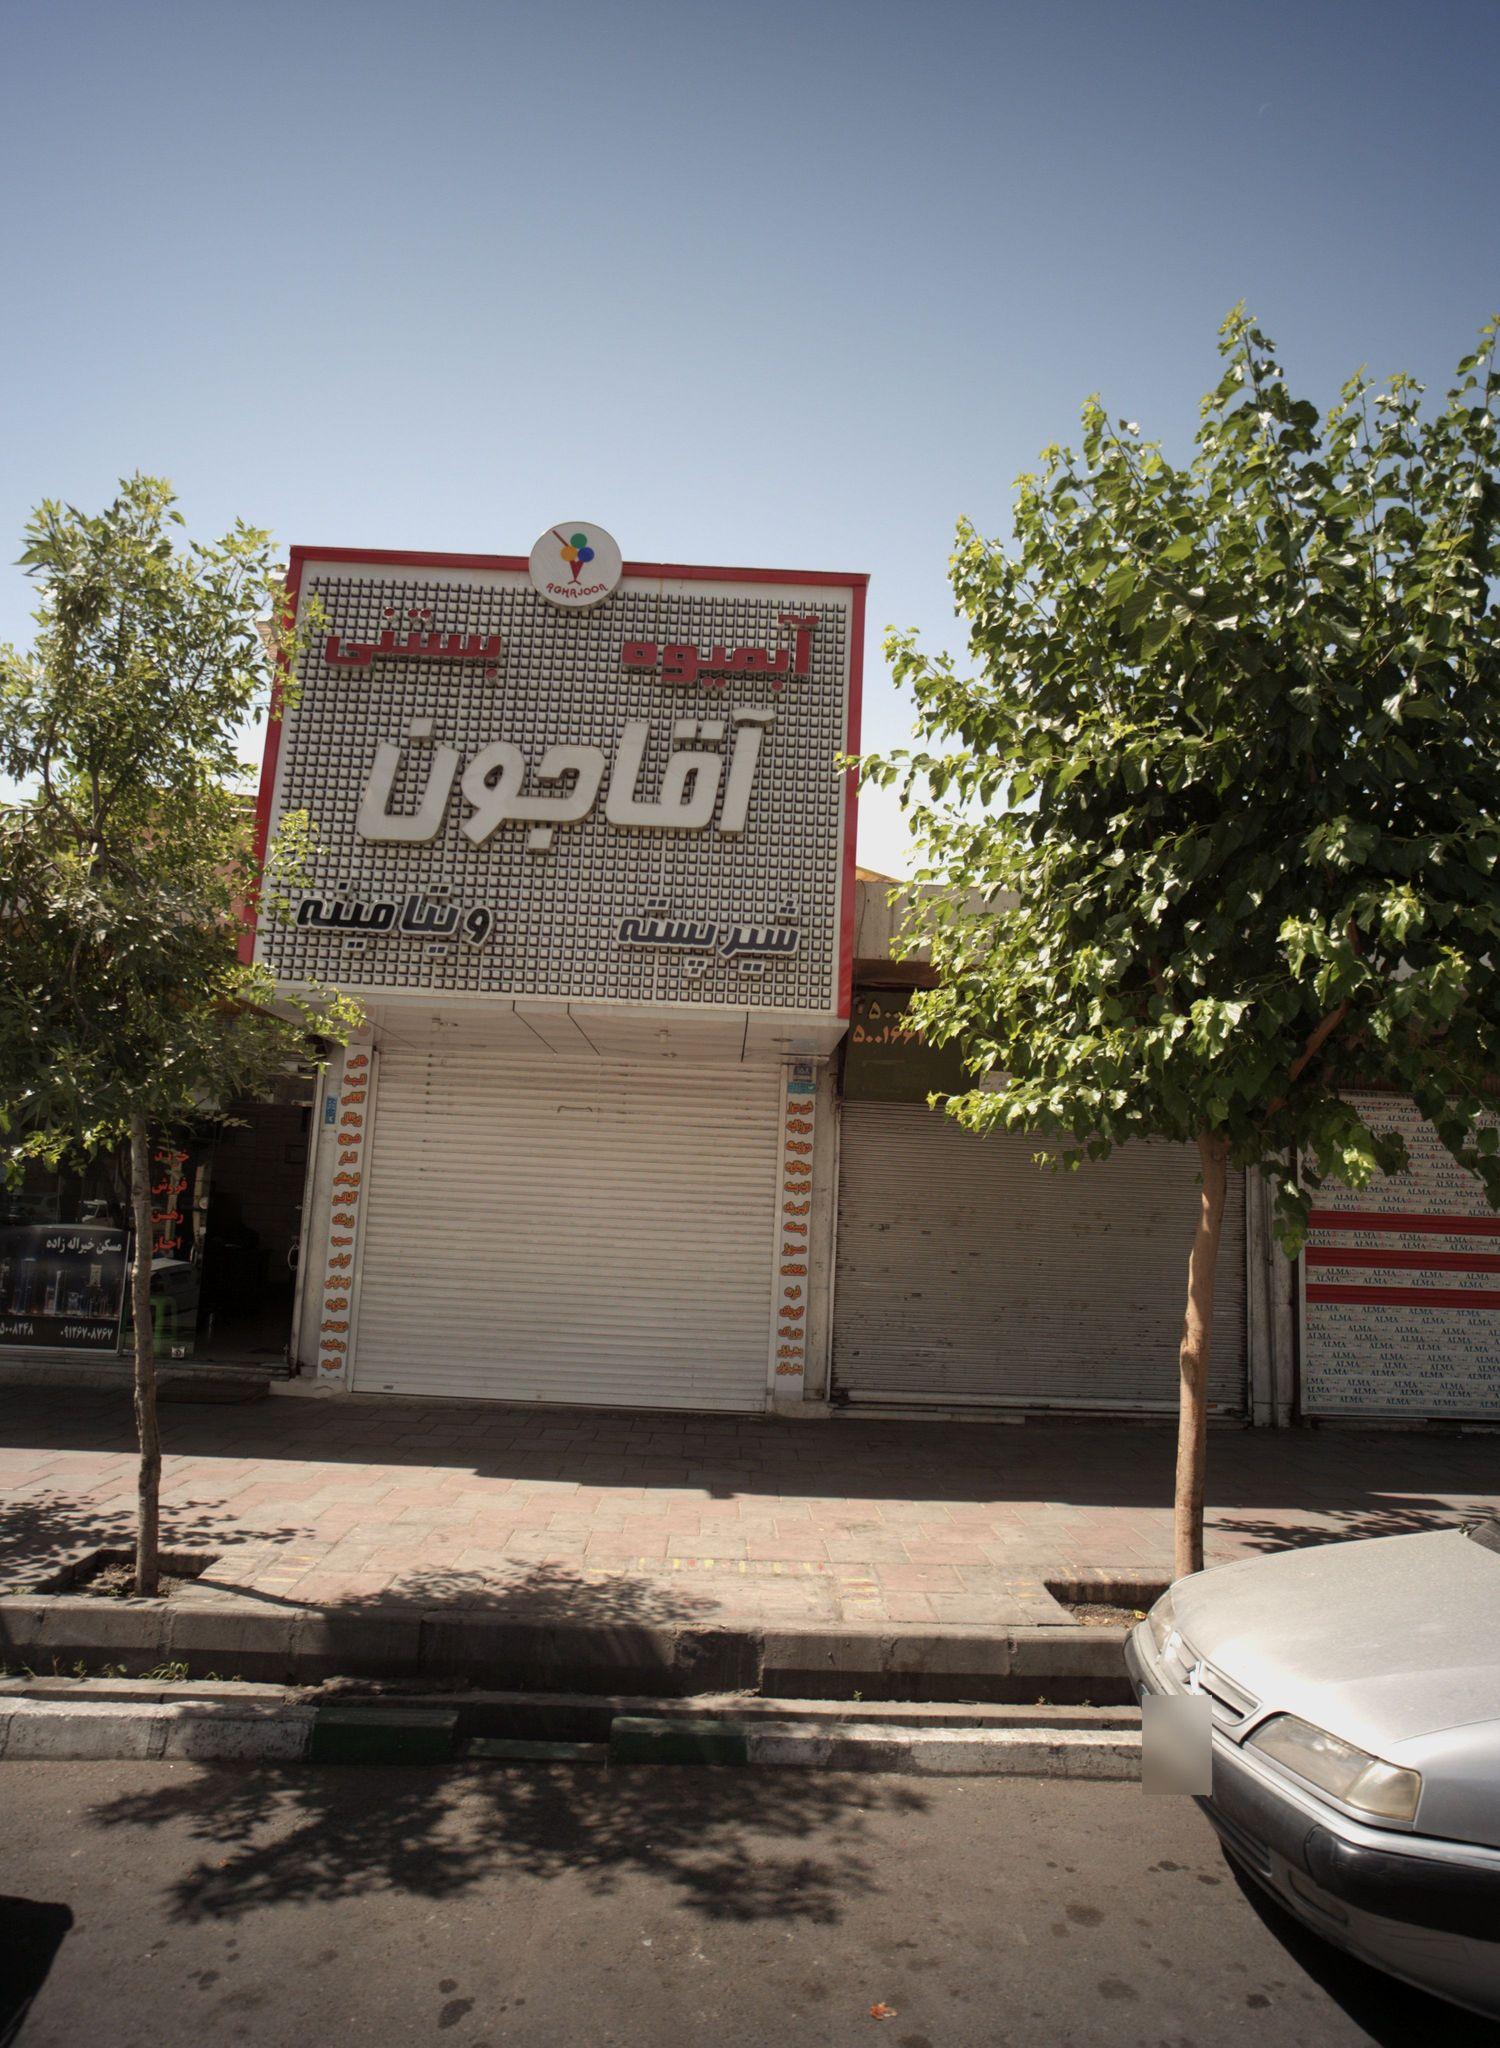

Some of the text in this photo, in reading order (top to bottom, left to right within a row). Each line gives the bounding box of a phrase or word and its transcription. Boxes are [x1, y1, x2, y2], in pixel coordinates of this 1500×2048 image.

[325, 606, 501, 682] بستنی
[622, 613, 820, 693] آبمیوه
[357, 706, 778, 854] آقاجون
[617, 899, 800, 978] شیر پسته
[1436, 1172, 1460, 1180] ALMA
[151, 1177, 188, 1194] فروش
[1353, 1231, 1377, 1239] ALMA
[1398, 1233, 1422, 1241] ALMA
[1444, 1235, 1468, 1243] ALMA
[46, 1236, 66, 1253] زاده
[96, 1239, 122, 1254] مسکن
[1373, 1269, 1396, 1277] ALMA
[1411, 1279, 1435, 1287] ALMA
[1421, 1317, 1445, 1325] ALMA
[1321, 1340, 1346, 1348] ALMA
[1475, 1356, 1500, 1364] ALMA
